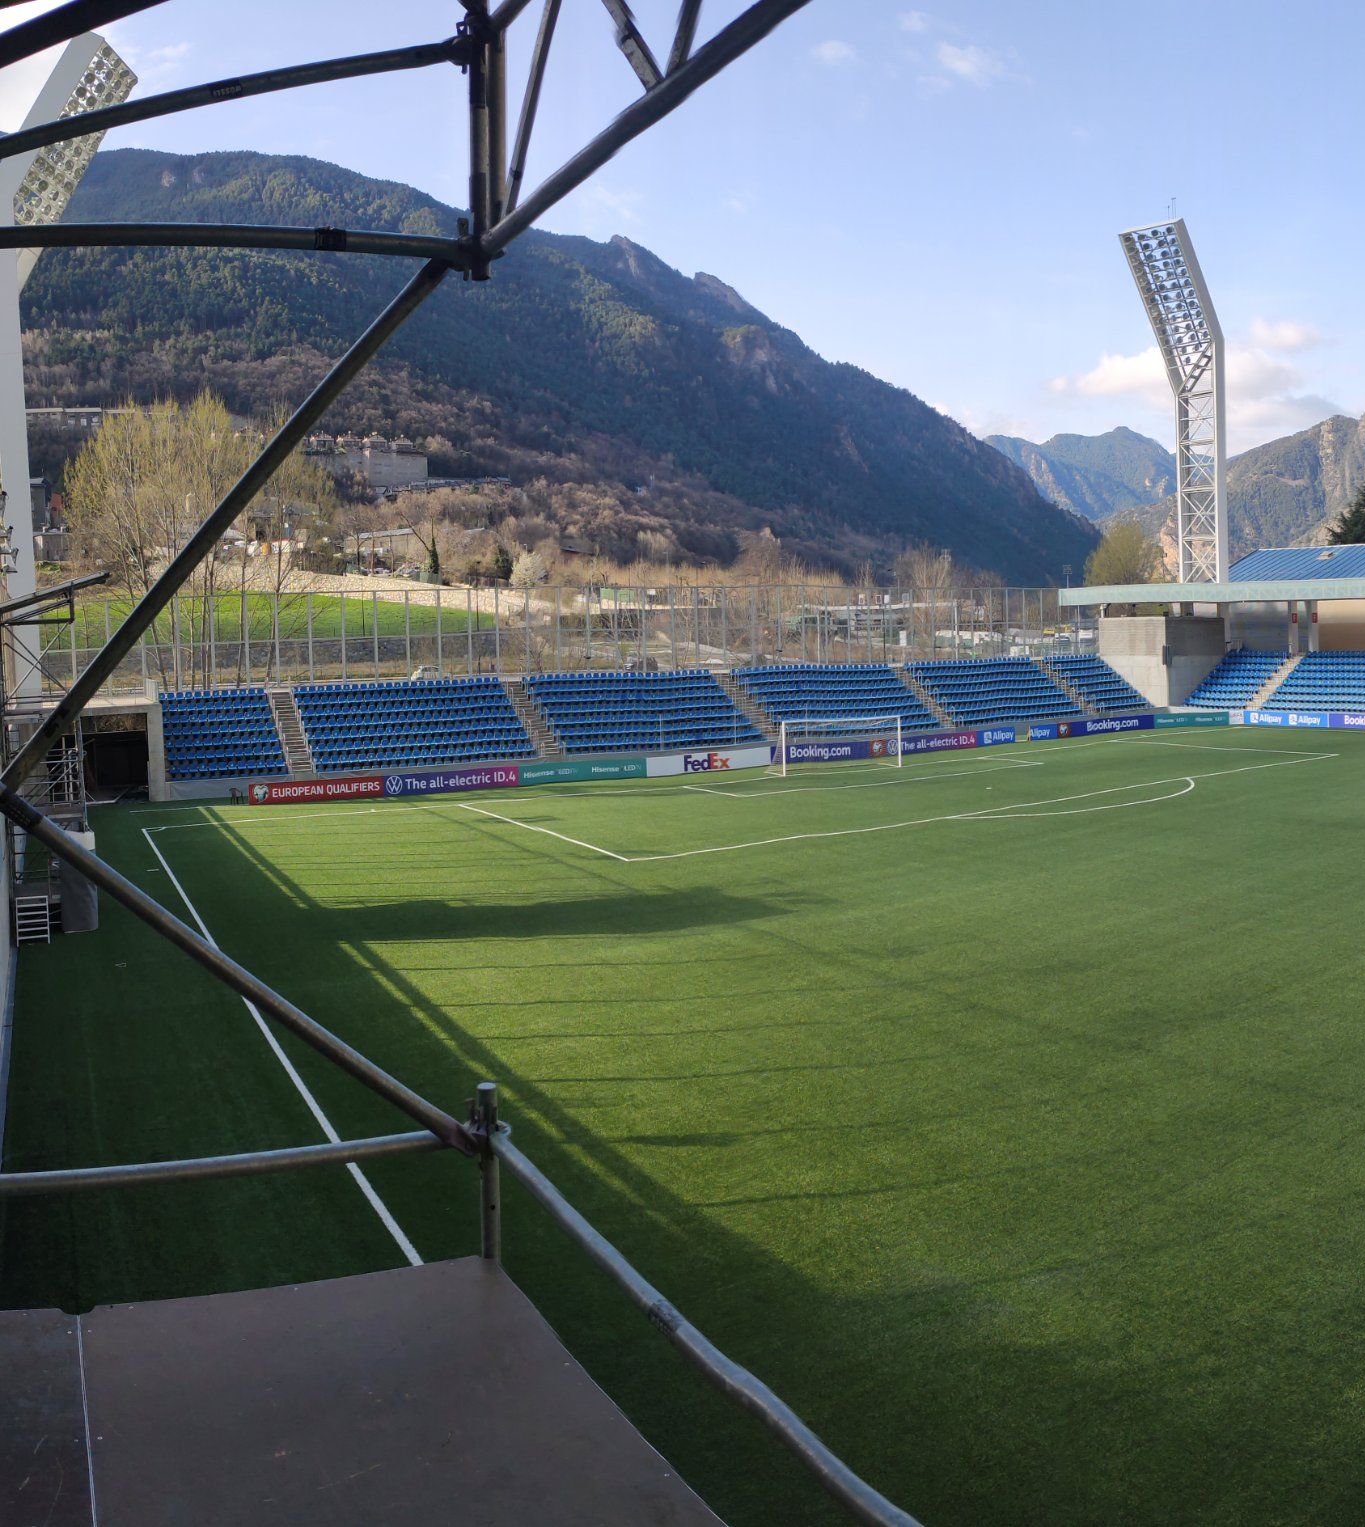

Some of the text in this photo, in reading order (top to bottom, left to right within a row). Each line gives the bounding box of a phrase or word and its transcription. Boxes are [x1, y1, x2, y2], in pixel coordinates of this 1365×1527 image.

[1087, 718, 1139, 731] Booking.com
[1259, 714, 1282, 724] Alipay
[1298, 715, 1320, 725] Alipay
[993, 731, 1013, 742] Alipay
[1030, 726, 1050, 738] Alipay
[901, 742, 915, 751] The
[917, 736, 957, 749] all-electric
[960, 735, 975, 745] ID.4
[790, 746, 850, 759] Booking.com
[684, 752, 730, 772] FedEx
[405, 779, 426, 789] The
[430, 773, 490, 788] all-electric
[494, 771, 516, 782] ID.4
[524, 770, 554, 778] Hisense
[272, 782, 380, 797] EUROPEAN QUALIFIERS
